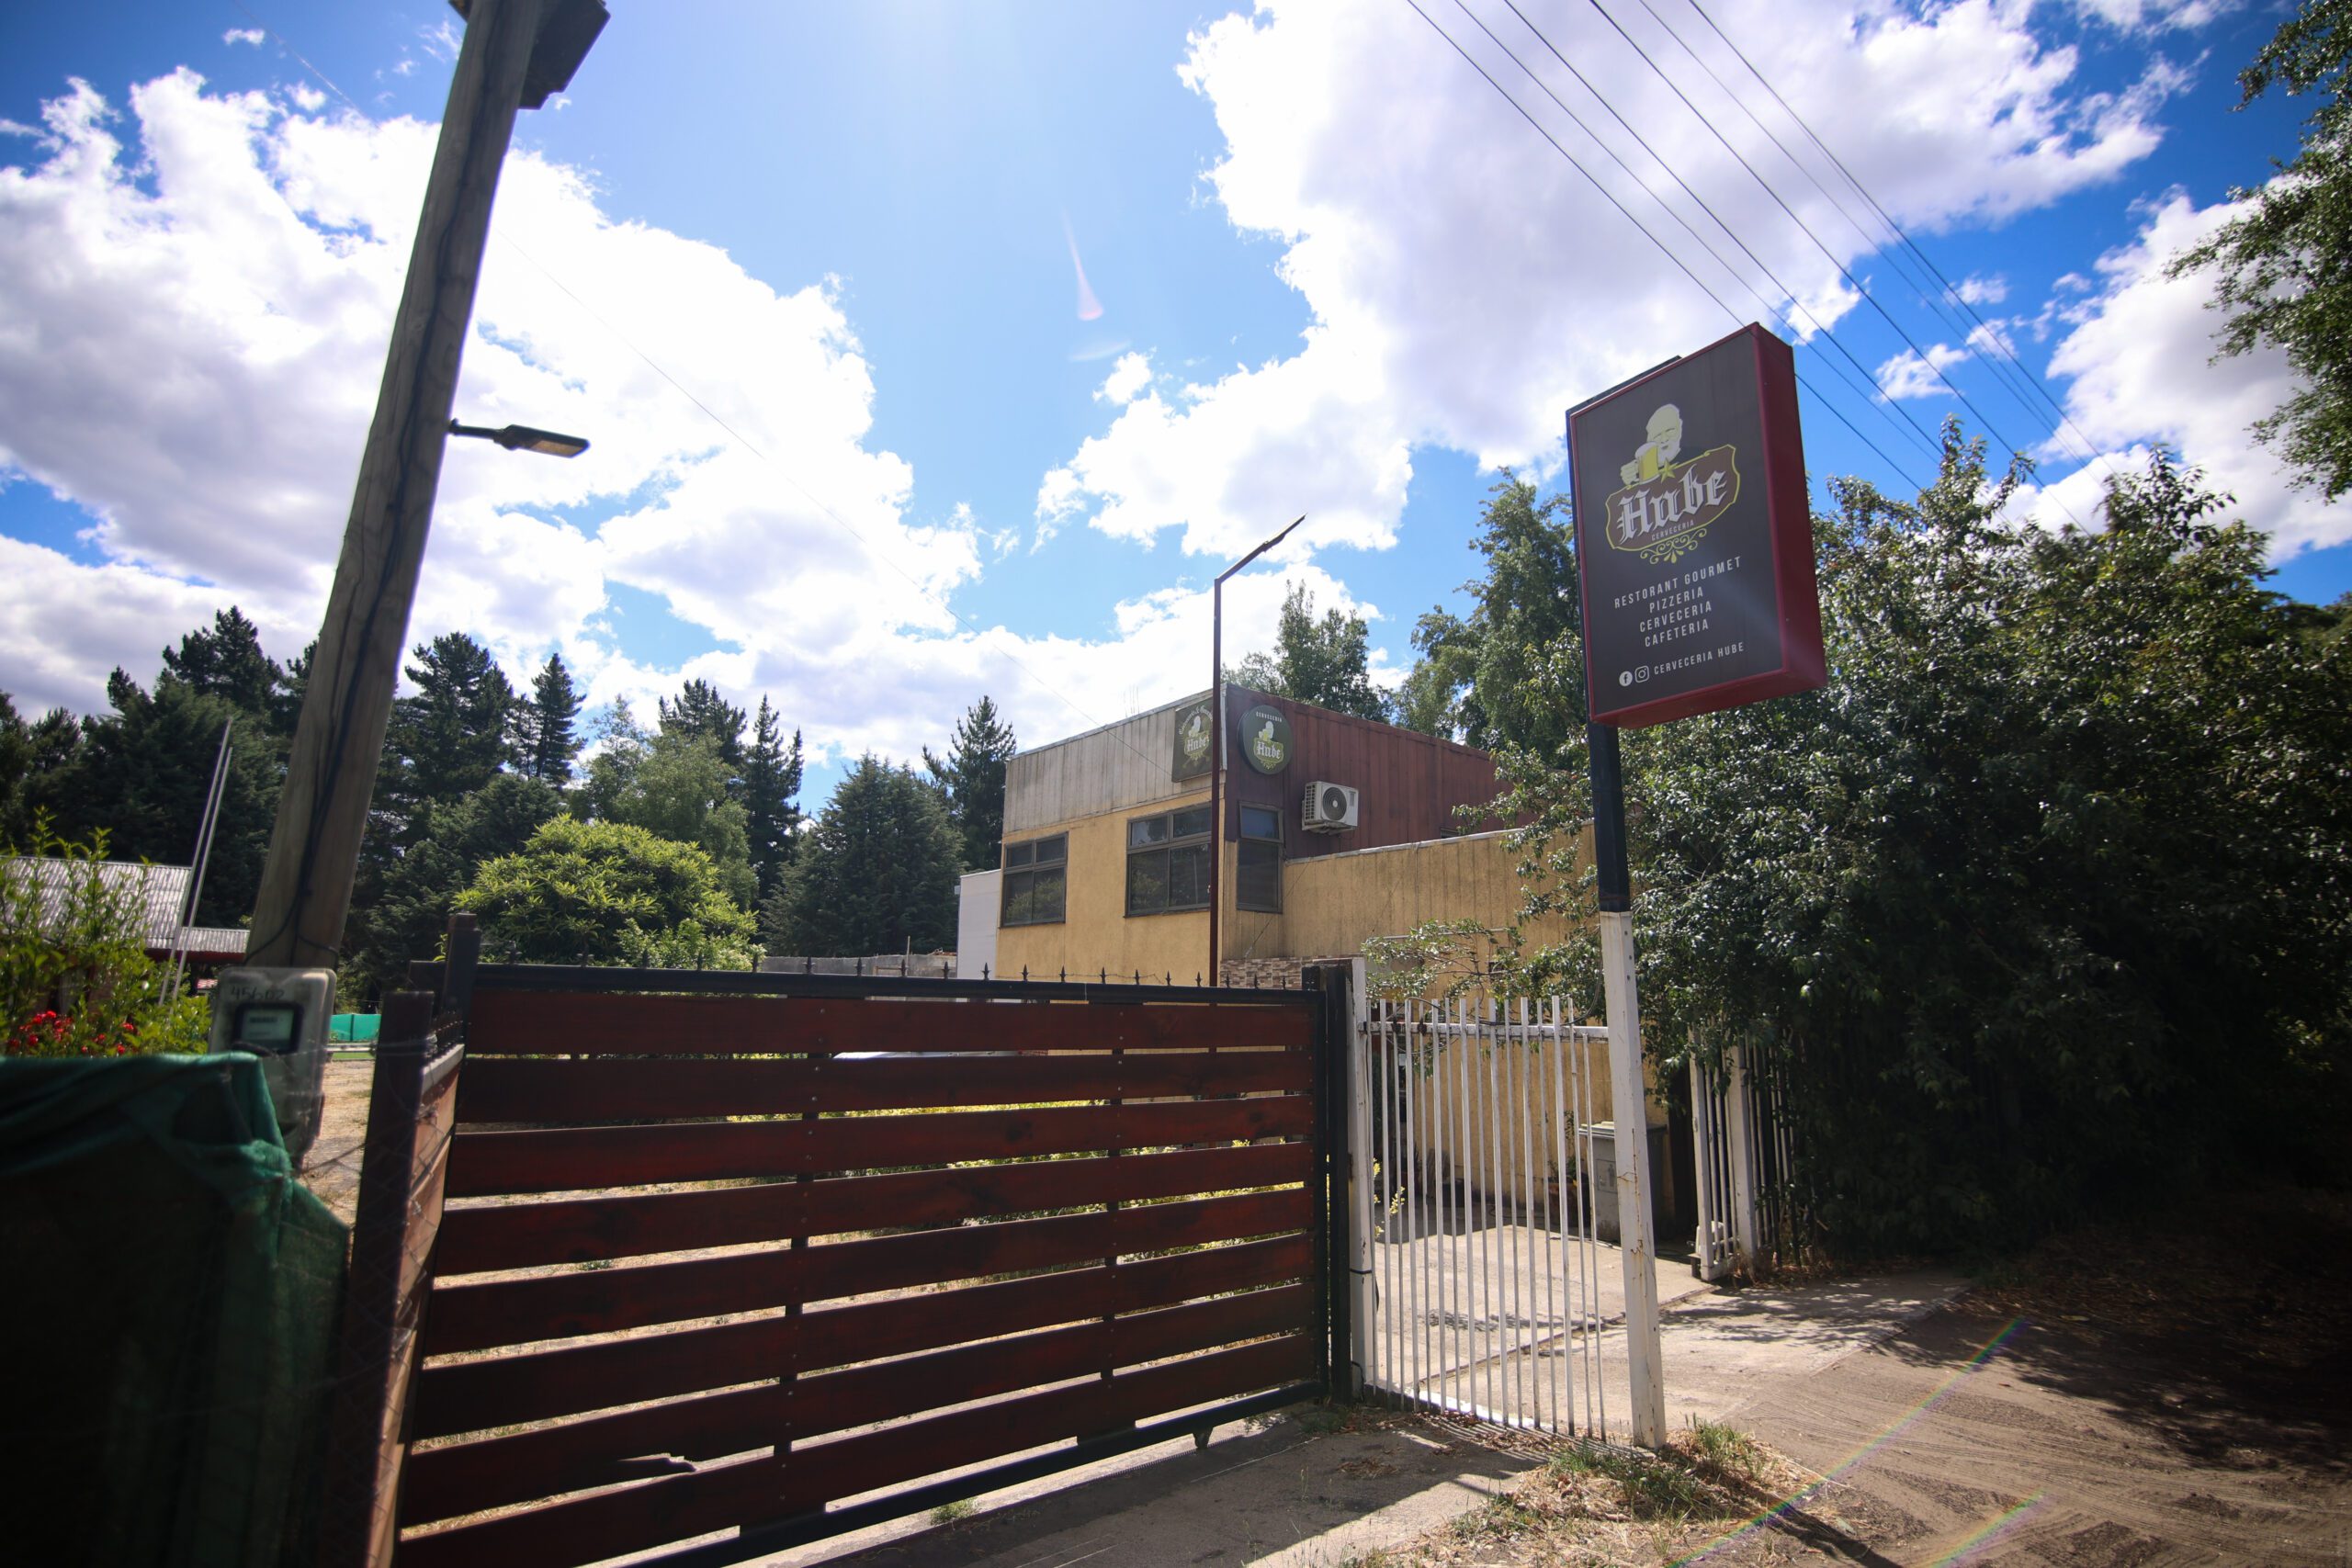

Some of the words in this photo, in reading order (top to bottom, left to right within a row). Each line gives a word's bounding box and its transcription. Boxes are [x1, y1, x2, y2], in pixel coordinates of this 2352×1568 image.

[1617, 463, 1728, 545] Hube
[1651, 519, 1695, 541] CERVECERIA
[1614, 578, 1679, 609] RESTORANT
[1684, 556, 1741, 585] GOURMET
[1649, 586, 1703, 614] PIZZERIA
[1639, 600, 1712, 633] CERVECERIA
[1645, 618, 1709, 648] CAFETERIA
[1654, 650, 1713, 675] CERVECERIA
[1717, 641, 1745, 659] HUBE
[1256, 740, 1281, 760] Hube
